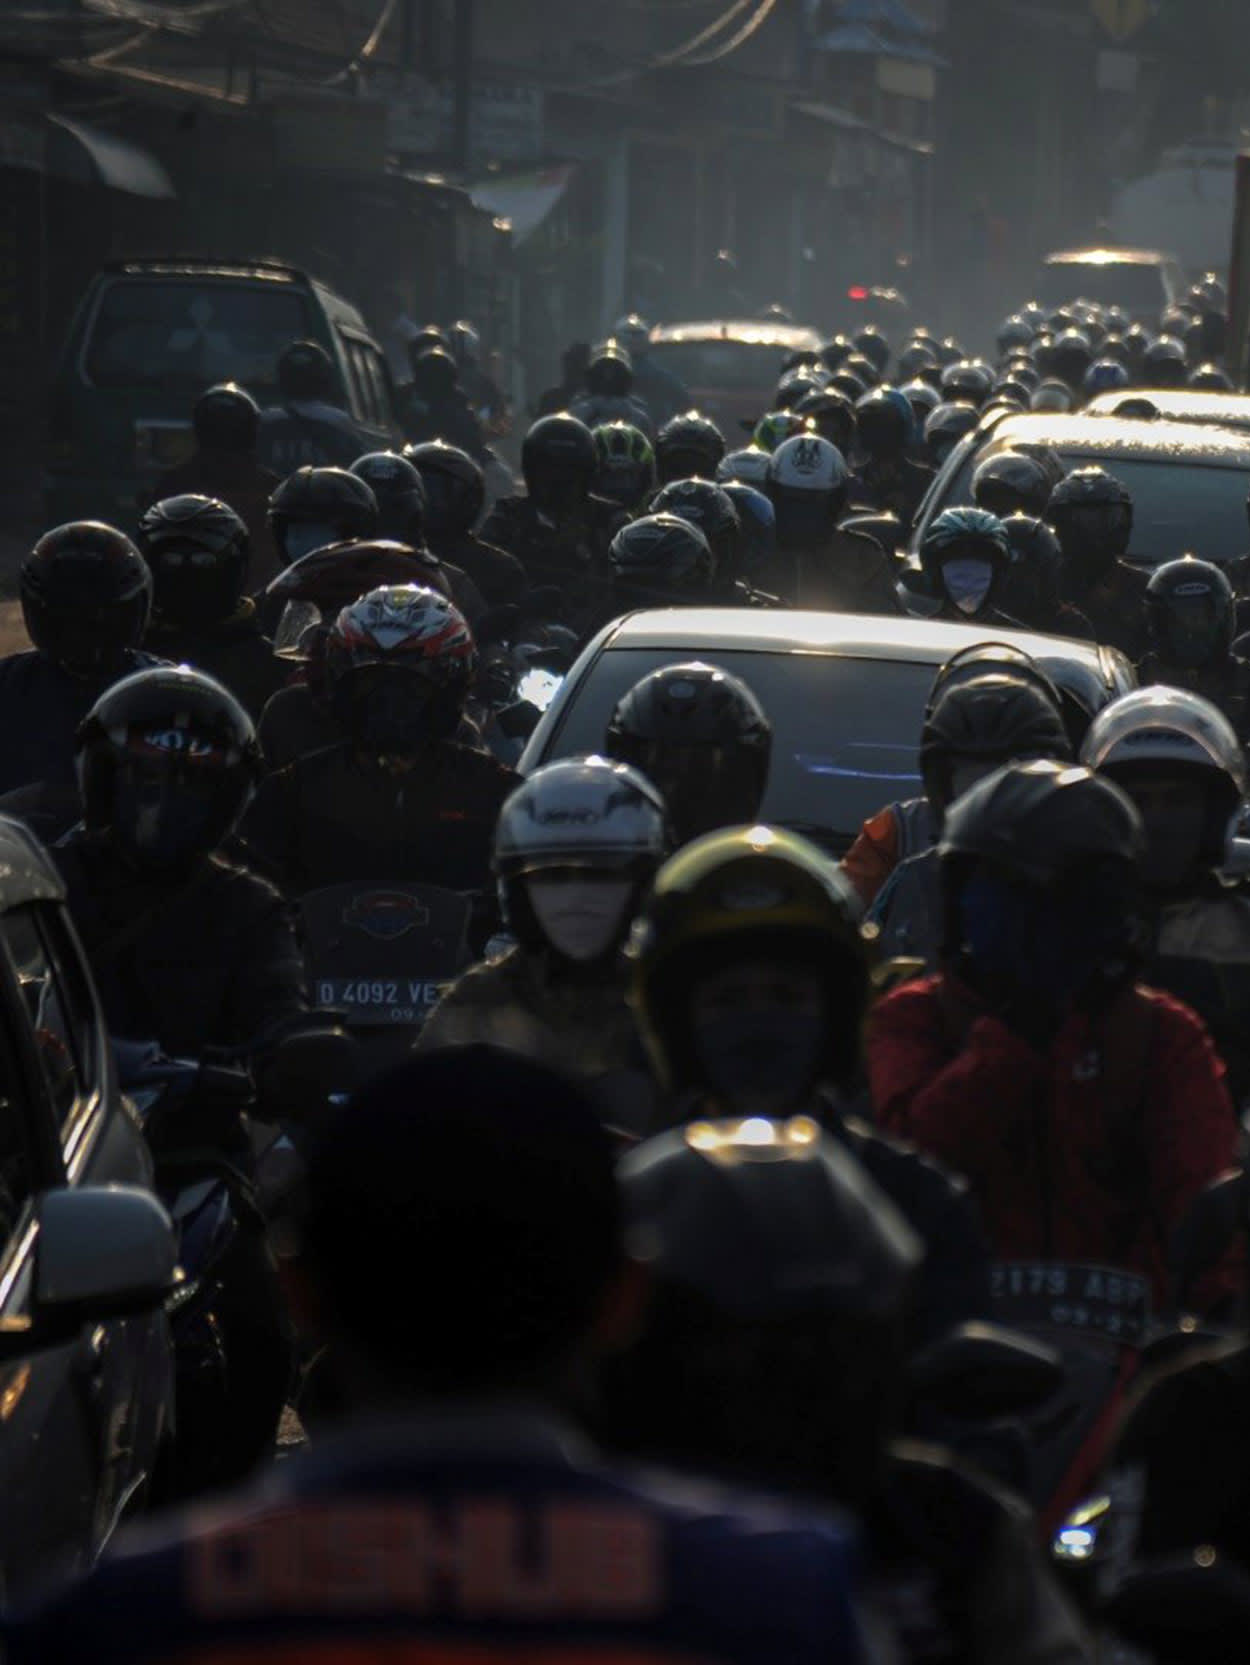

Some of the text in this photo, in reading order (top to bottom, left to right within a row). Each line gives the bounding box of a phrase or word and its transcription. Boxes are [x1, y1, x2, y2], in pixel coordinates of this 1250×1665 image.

[342, 982, 399, 1004] 4092
[409, 982, 437, 1004] VE
[187, 1498, 664, 1621] DISHUB
